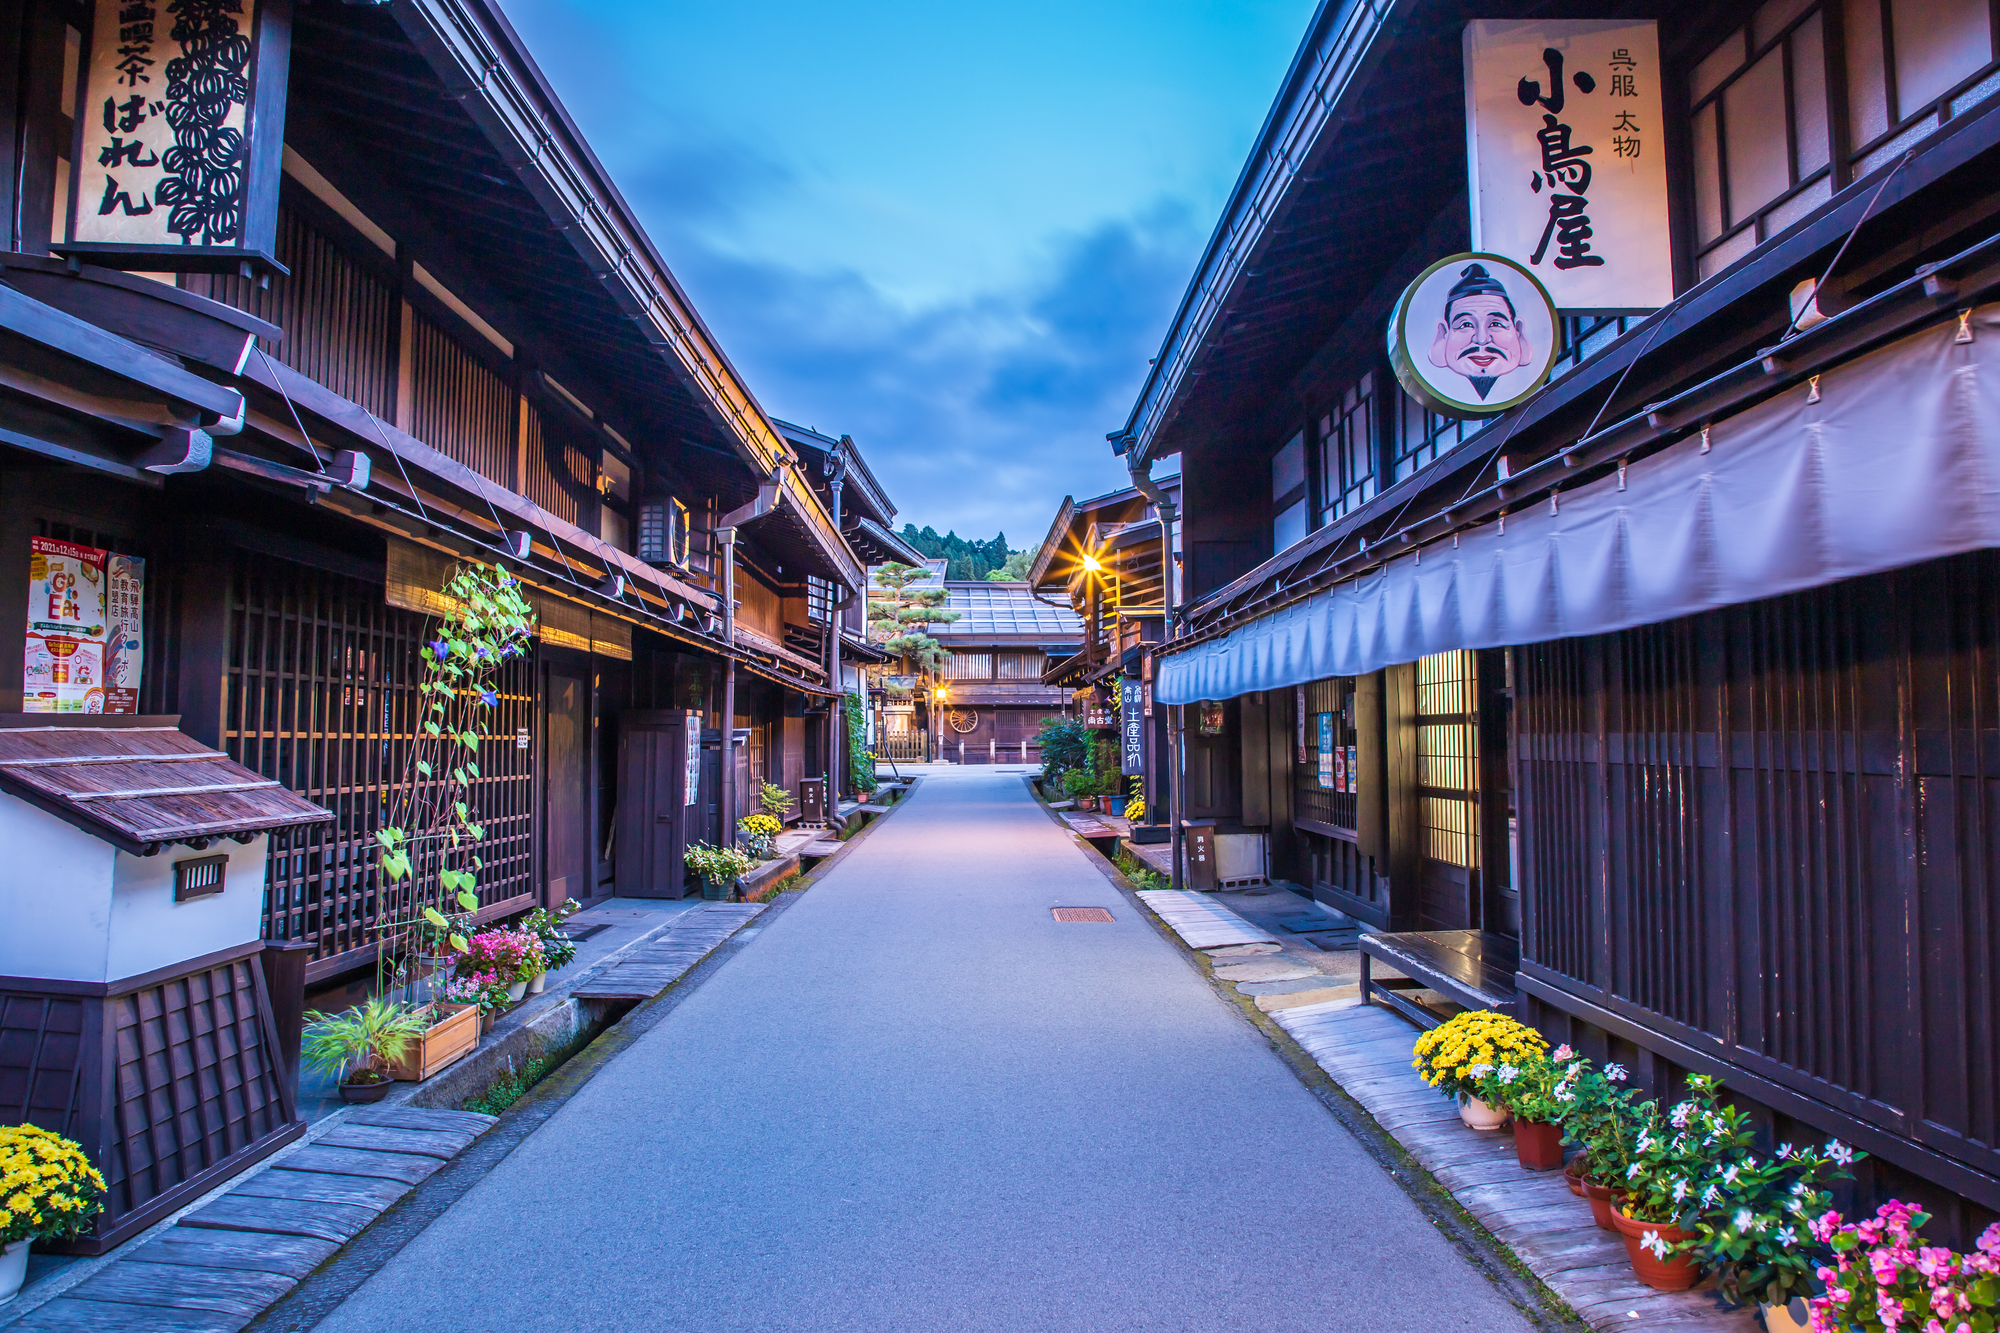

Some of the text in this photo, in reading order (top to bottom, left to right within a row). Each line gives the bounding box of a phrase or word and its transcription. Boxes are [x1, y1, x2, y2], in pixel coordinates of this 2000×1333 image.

[115, 0, 156, 87] 画喫茶
[97, 94, 165, 217] ばれん
[1609, 48, 1641, 159] 呉服 太物
[1517, 47, 1605, 270] 小鳥屋
[48, 593, 80, 621] Eat
[111, 578, 119, 617] 加盟店
[120, 578, 129, 684] 教育旅行クーポン
